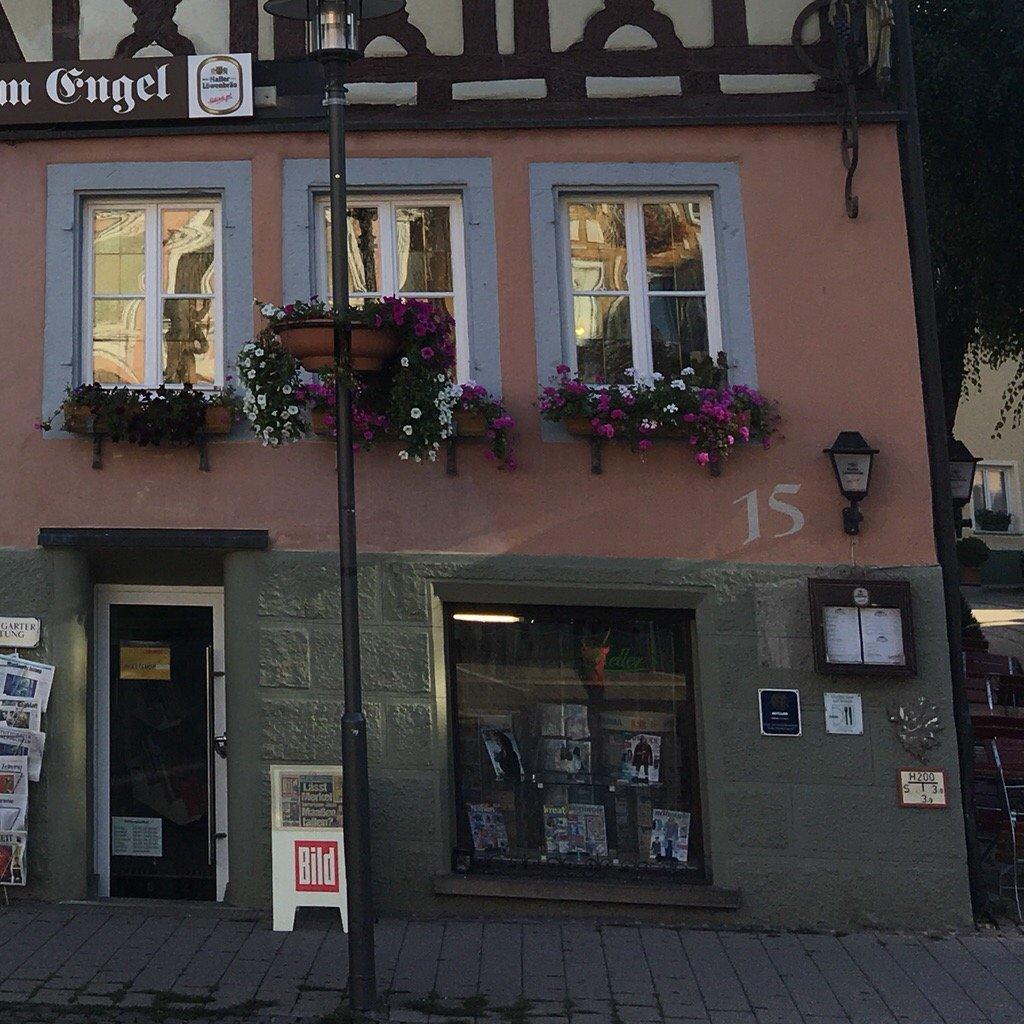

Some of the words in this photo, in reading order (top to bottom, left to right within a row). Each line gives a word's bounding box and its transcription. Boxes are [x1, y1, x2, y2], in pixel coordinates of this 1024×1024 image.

[46, 63, 171, 114] Engel
[733, 483, 805, 545] 15
[299, 846, 335, 885] Bild
